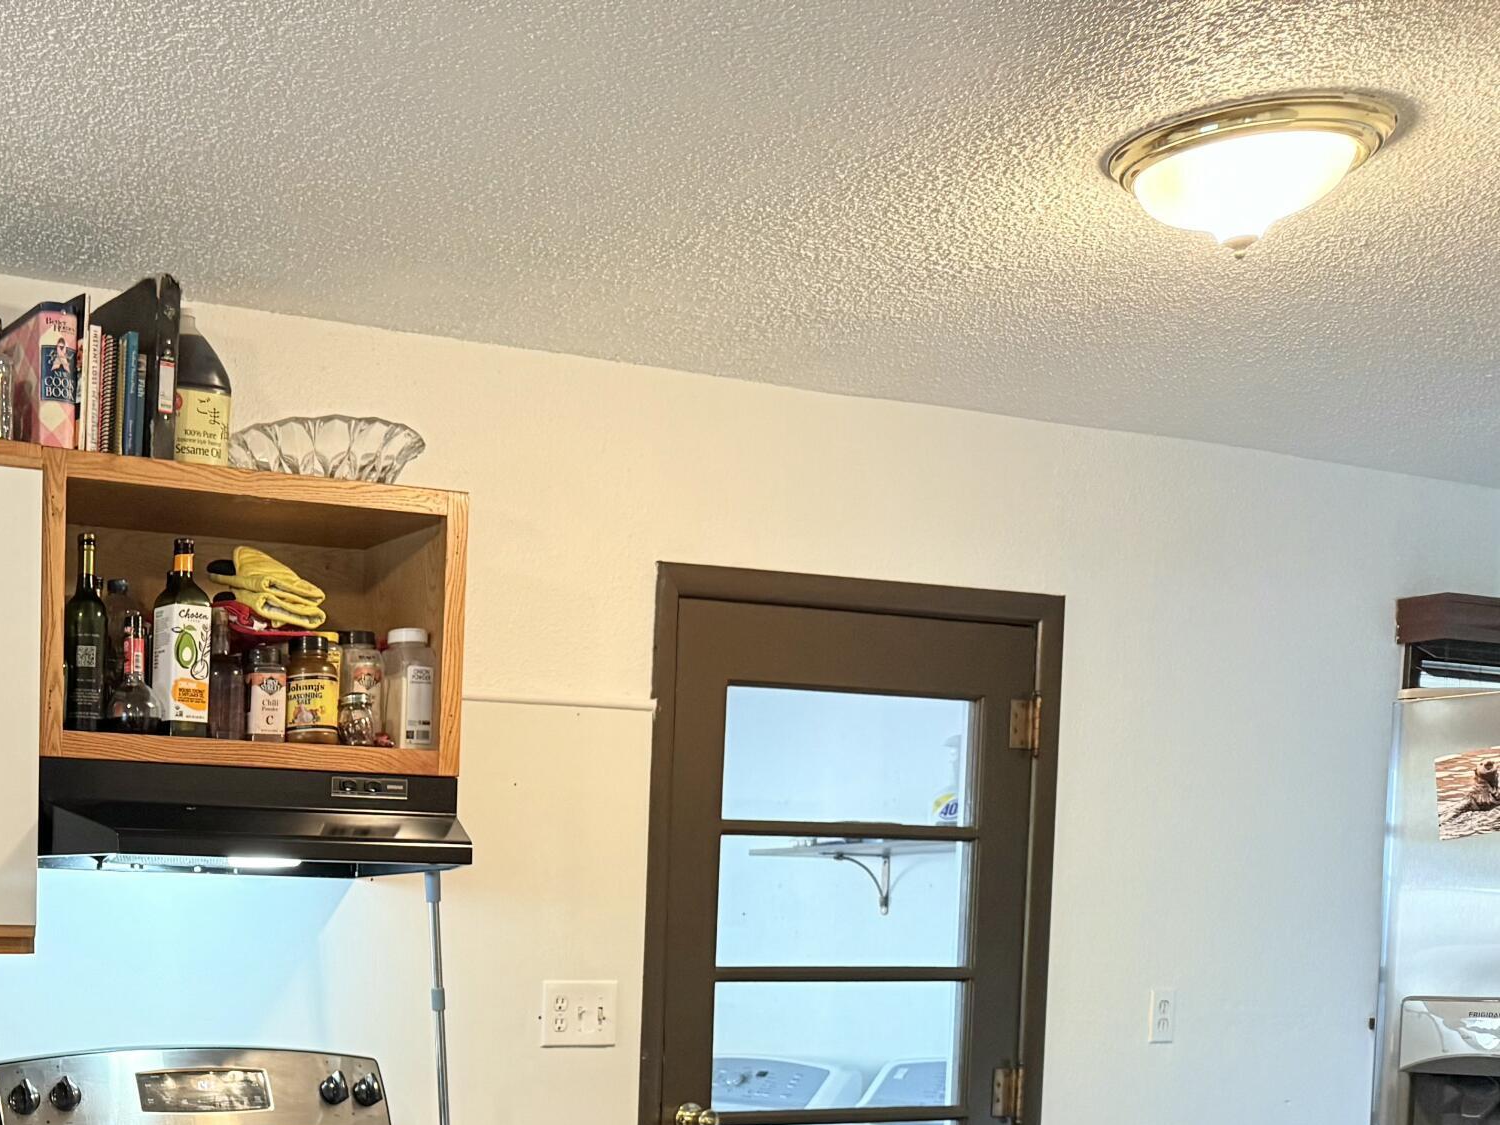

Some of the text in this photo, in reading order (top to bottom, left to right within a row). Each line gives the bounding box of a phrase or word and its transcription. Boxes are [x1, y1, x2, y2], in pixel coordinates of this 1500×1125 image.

[45, 376, 74, 392] COOK
[45, 386, 75, 400] BOOK
[203, 431, 217, 440] Pure
[175, 443, 222, 459] Sesame Oil
[178, 608, 209, 620] Chosen
[288, 692, 323, 700] EASONING
[261, 699, 279, 707] Chili
[266, 715, 274, 726] C
[940, 802, 959, 817] 40
[1468, 1011, 1500, 1019] FRIGIDA
